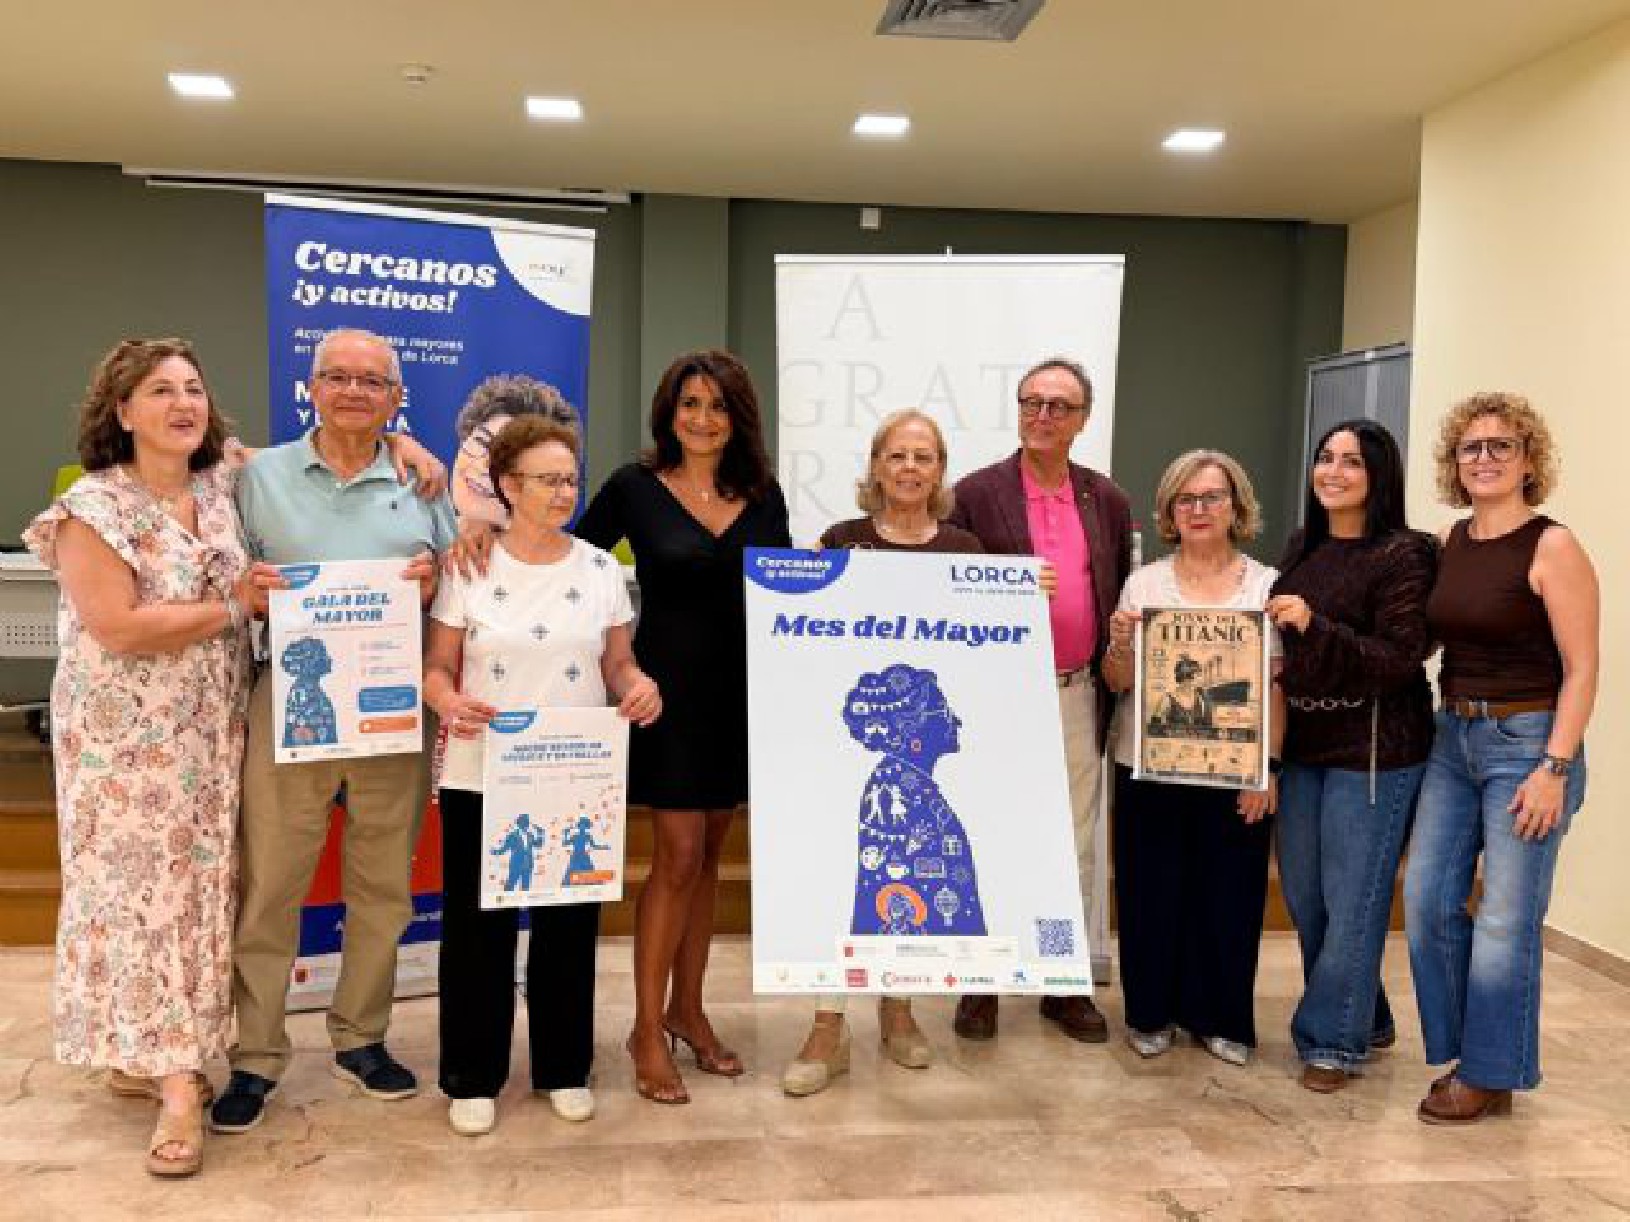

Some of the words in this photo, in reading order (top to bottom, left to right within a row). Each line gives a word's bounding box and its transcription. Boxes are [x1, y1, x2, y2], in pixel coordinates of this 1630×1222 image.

[295, 241, 497, 287] Cercanos
[292, 279, 326, 306] ¡y
[331, 285, 457, 313] activos!
[822, 273, 887, 340] A
[756, 556, 832, 571] Cercanos
[950, 564, 1037, 586] LORCA
[771, 612, 846, 638] Mes
[853, 614, 907, 640] del
[914, 617, 1031, 647] Mayor
[1157, 622, 1251, 642] TITANIC
